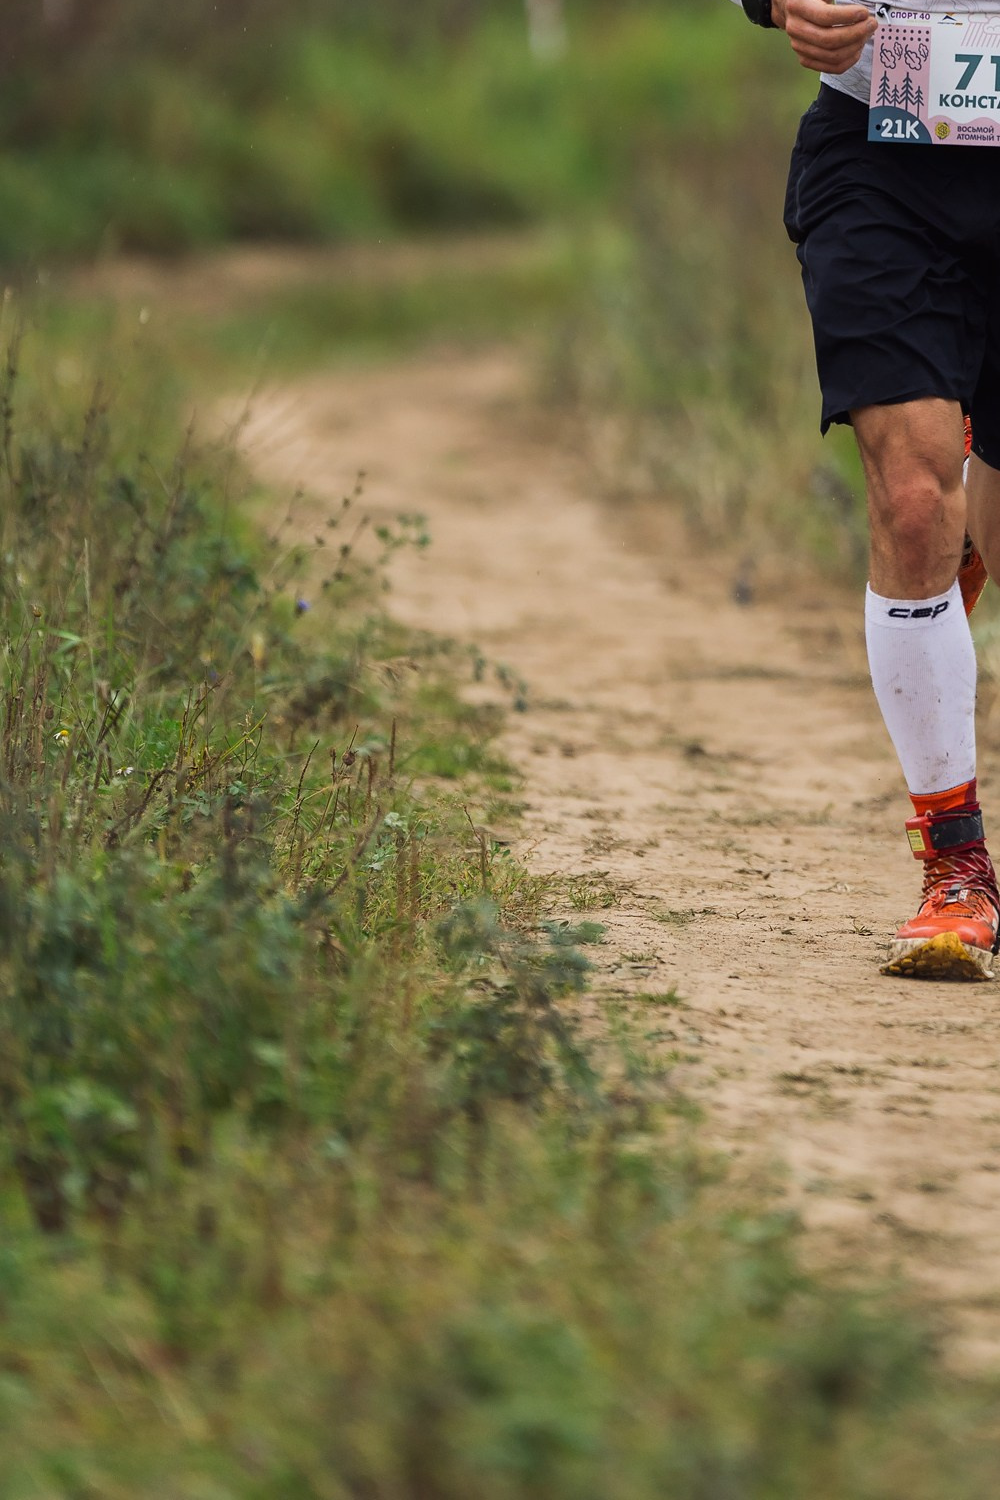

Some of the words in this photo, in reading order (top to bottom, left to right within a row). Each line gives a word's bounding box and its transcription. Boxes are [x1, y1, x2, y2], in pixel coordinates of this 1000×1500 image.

[890, 11, 917, 20] СПОРТ
[880, 118, 920, 140] 21K
[957, 125, 994, 134] ВОСЬМОЙ
[956, 133, 995, 142] АТОМНЫЙ
